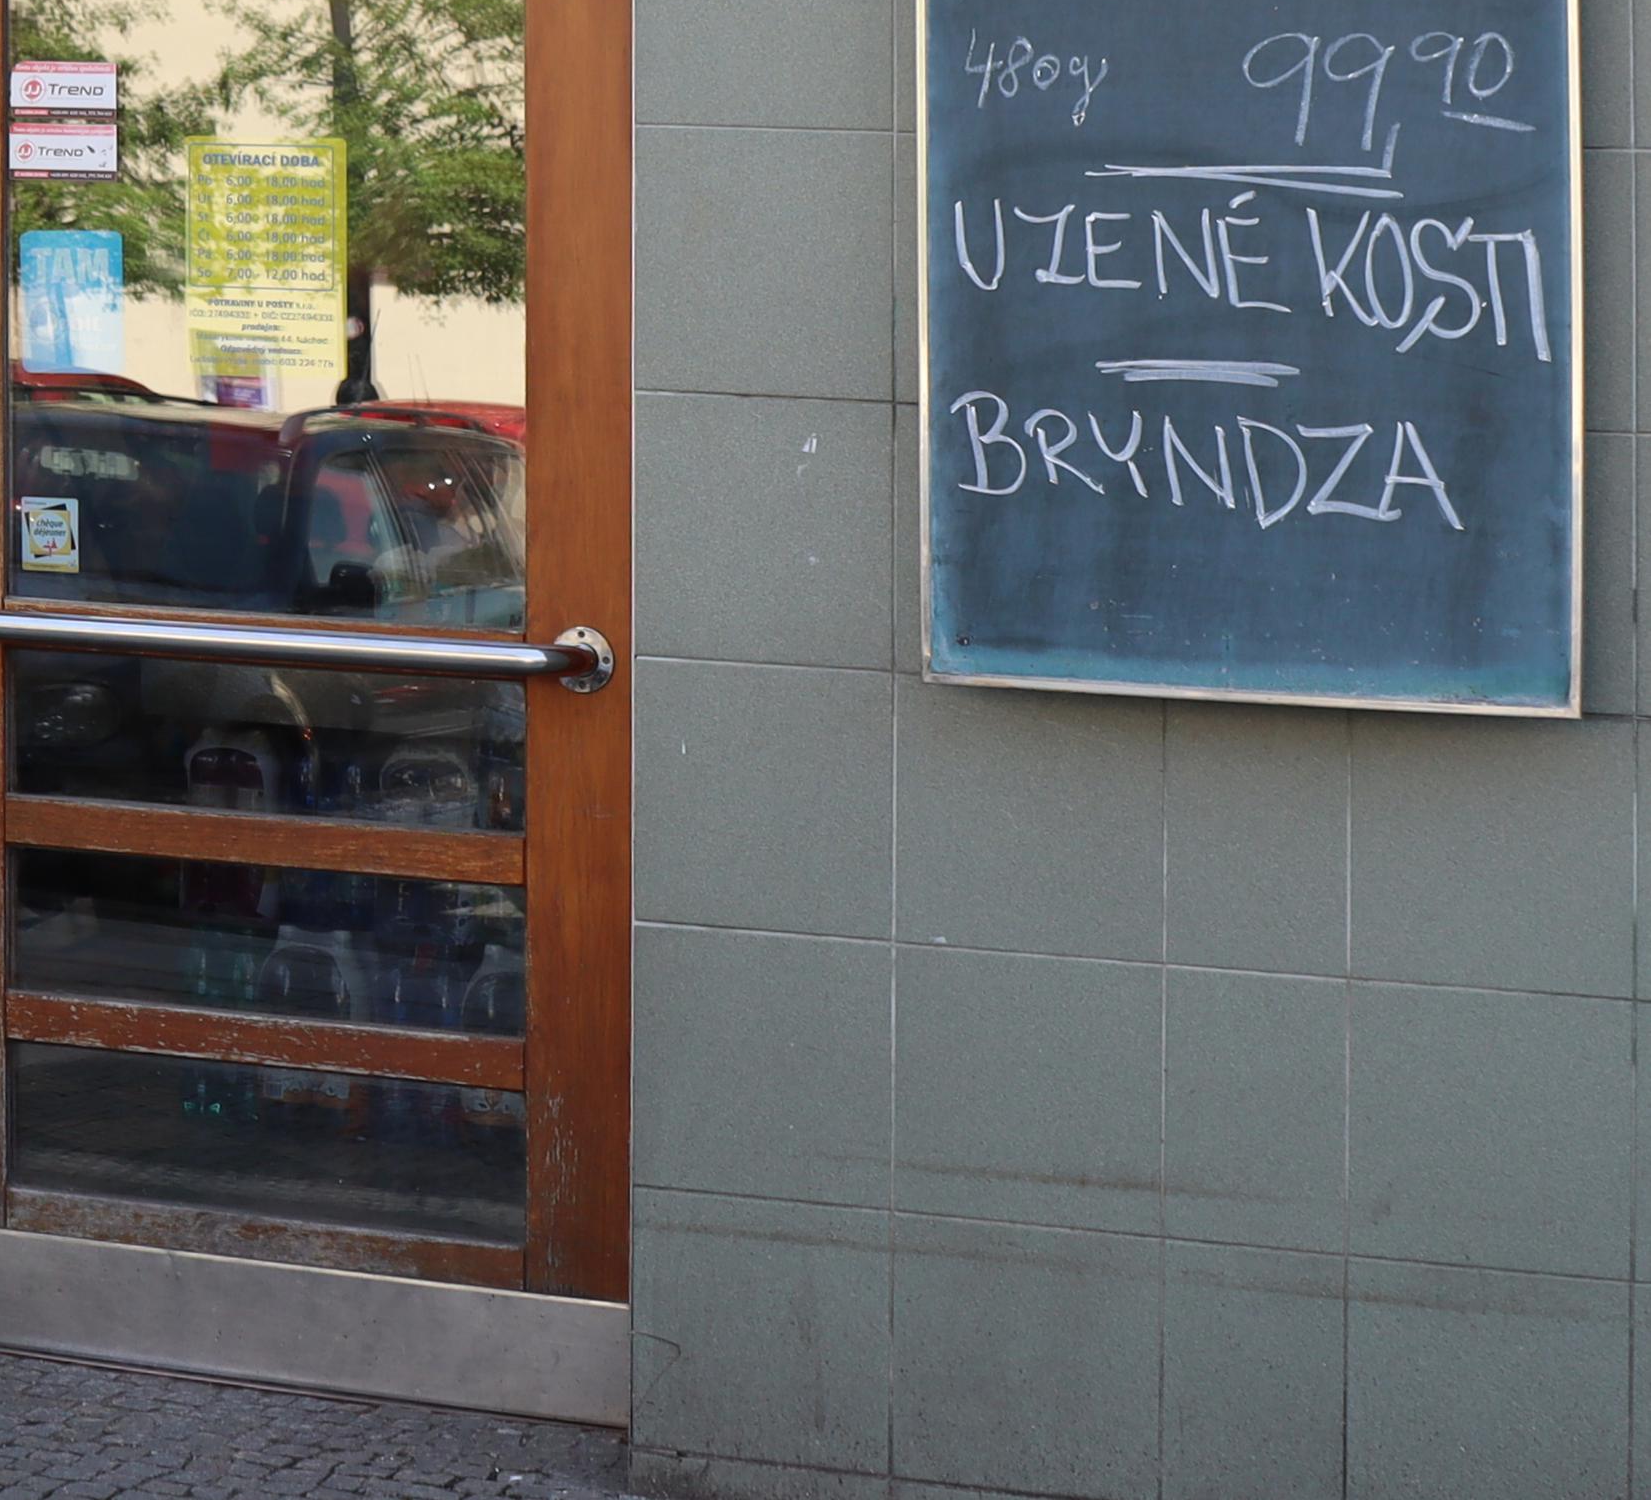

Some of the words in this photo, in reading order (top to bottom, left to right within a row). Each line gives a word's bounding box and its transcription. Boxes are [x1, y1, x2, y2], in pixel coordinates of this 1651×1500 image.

[965, 28, 1109, 128] 480g
[202, 151, 276, 166] OTEVÍRACÍ
[280, 155, 320, 167] DOBA
[954, 191, 1292, 313] UZENÉ
[1306, 210, 1552, 362] KOSTI
[951, 391, 1464, 530] BRYNDZA
